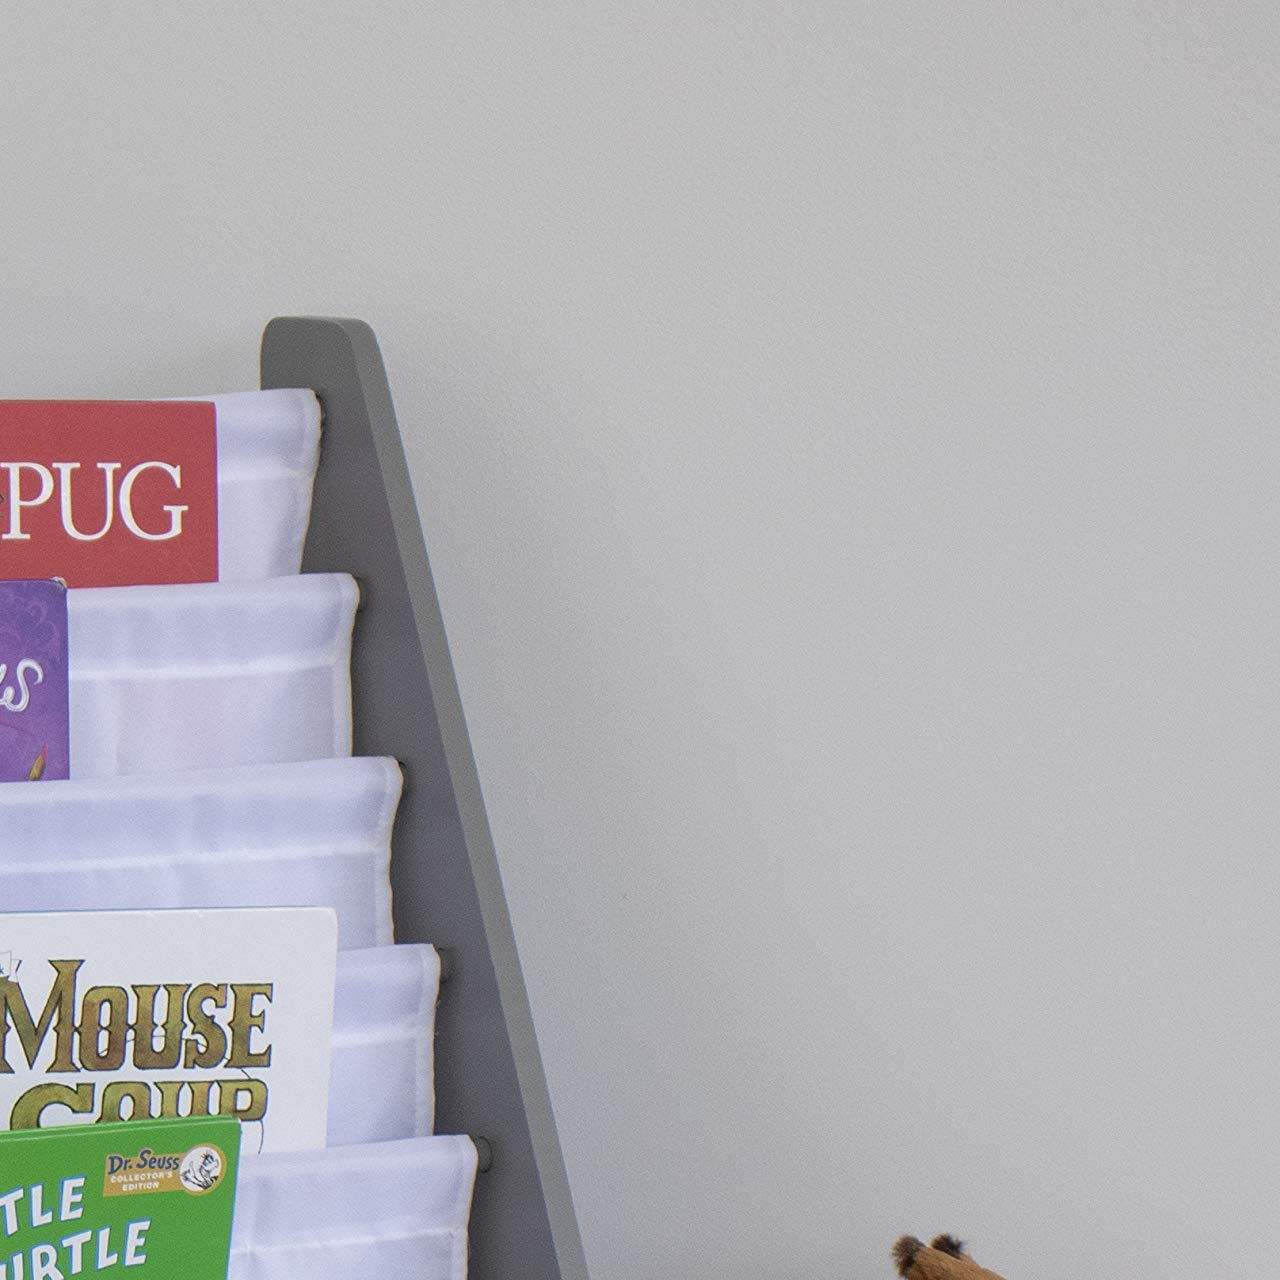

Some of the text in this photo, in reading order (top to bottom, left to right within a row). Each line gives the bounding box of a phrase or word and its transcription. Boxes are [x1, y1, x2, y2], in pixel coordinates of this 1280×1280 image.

[0, 460, 189, 541] PUG
[107, 1149, 180, 1175] Dr. Seuss
[109, 1171, 174, 1183] COLLECTOR'S
[122, 1181, 160, 1192] EDITION
